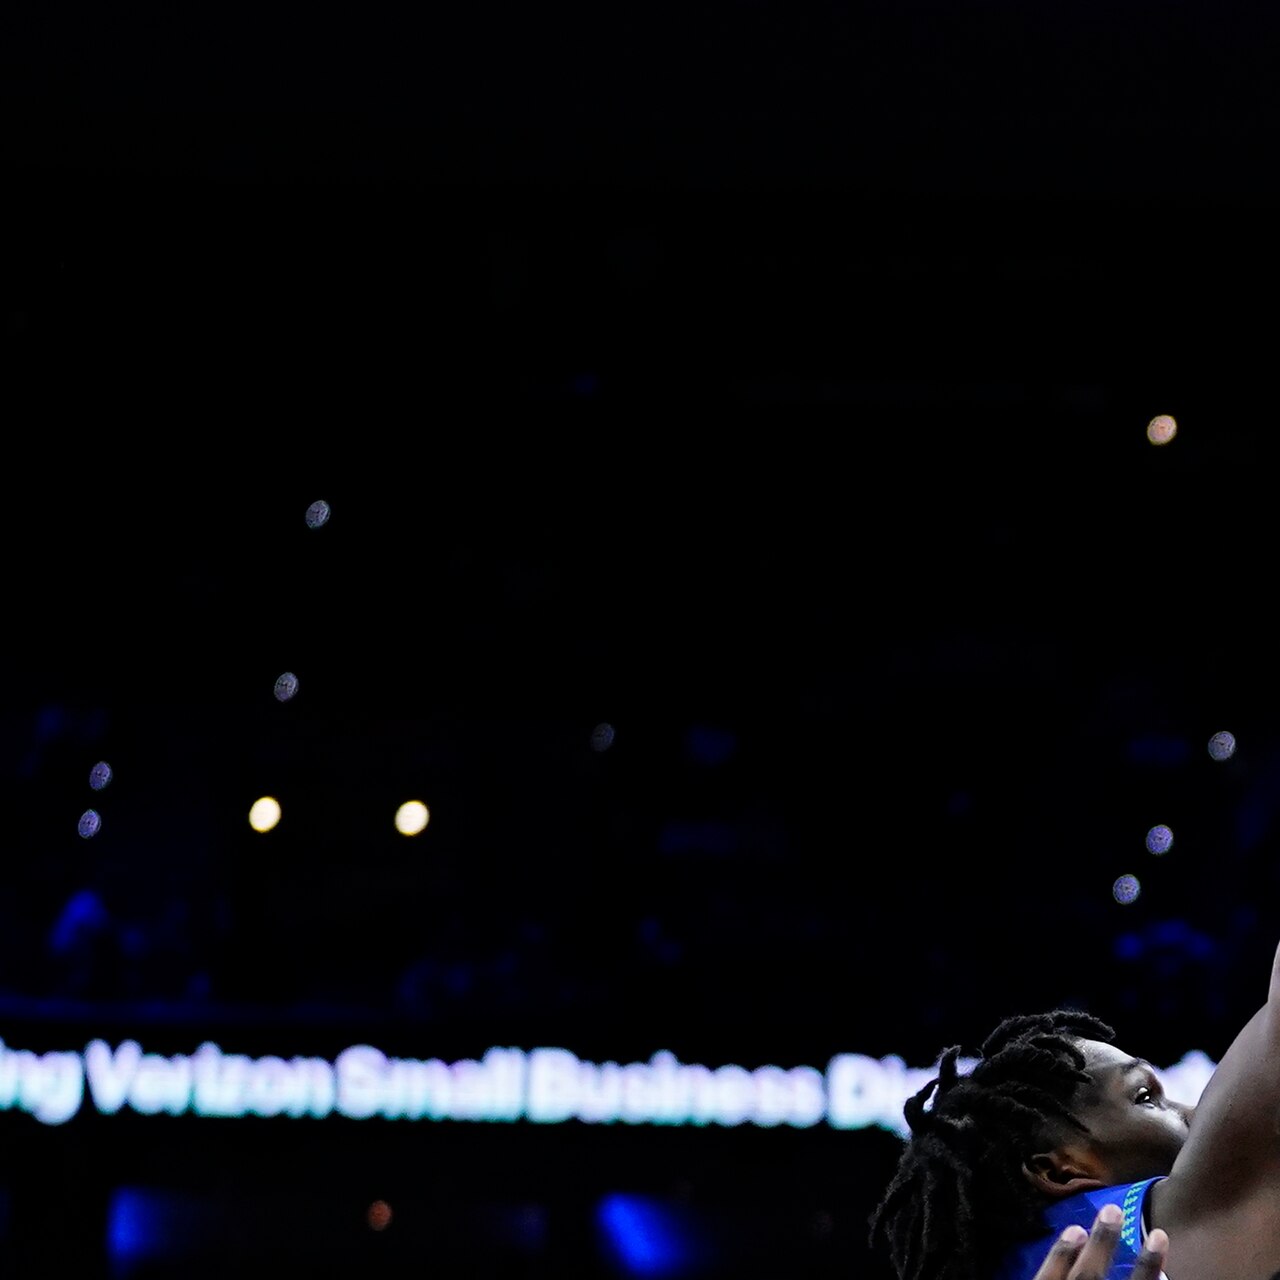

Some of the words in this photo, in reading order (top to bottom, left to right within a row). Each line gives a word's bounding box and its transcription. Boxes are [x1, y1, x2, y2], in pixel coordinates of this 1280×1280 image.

[0, 1040, 82, 1123] ng
[86, 1040, 335, 1117] Verizon
[335, 1046, 526, 1122] Small
[527, 1049, 828, 1127] Business
[828, 1054, 928, 1135] Di
